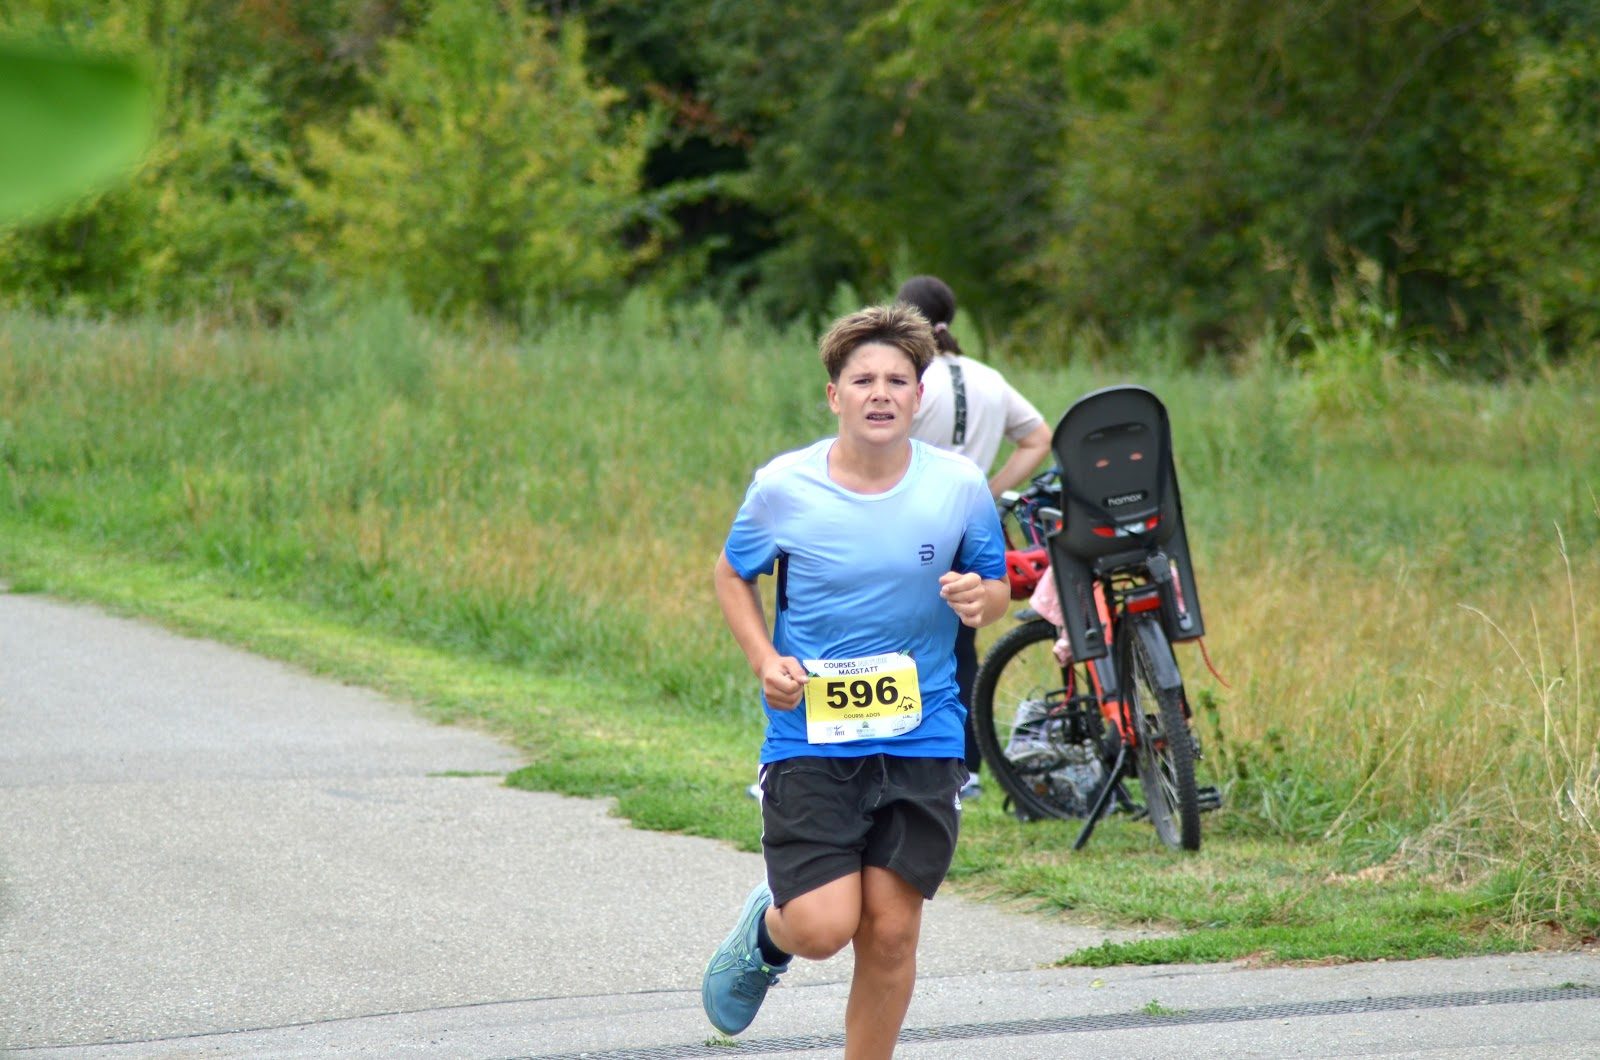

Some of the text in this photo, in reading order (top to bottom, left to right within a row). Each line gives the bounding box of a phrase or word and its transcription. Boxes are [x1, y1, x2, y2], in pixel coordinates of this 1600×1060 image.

[823, 661, 857, 669] COURSES
[838, 665, 879, 675] MAGSTATT
[826, 676, 899, 709] 596
[903, 703, 914, 711] 3K
